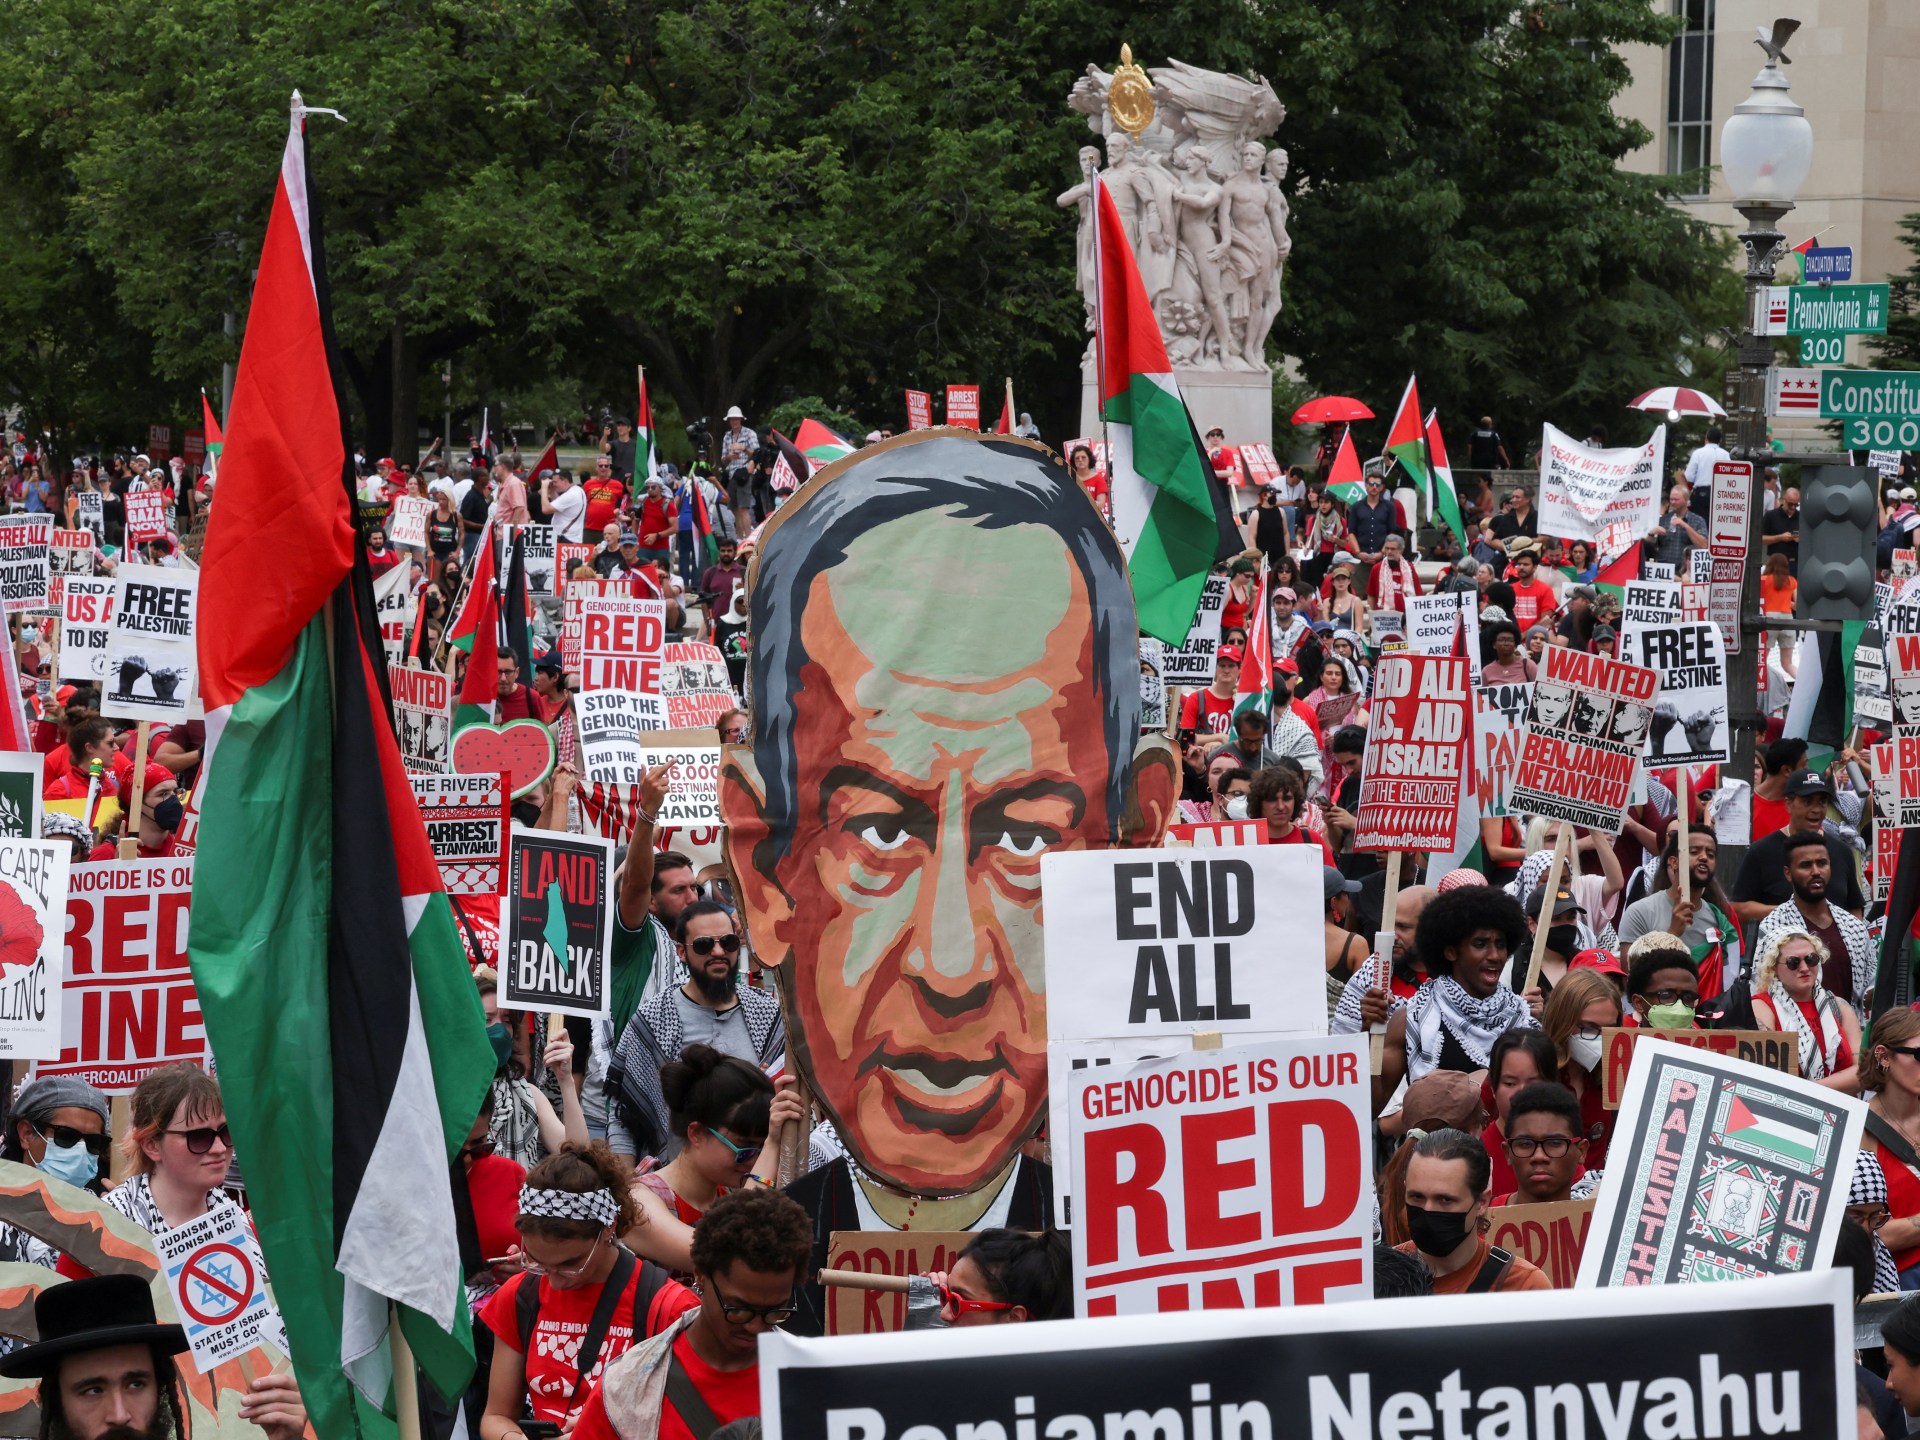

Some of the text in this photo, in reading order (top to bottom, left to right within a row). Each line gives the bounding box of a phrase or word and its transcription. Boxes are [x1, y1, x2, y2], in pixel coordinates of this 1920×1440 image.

[1805, 255, 1850, 274] EVACUATION ROUTE
[1792, 290, 1879, 331] Pennsylvania Ave
[1867, 309, 1879, 327] NW
[1802, 338, 1842, 361] 300
[908, 393, 926, 408] STOP
[948, 391, 977, 403] ARREST
[1828, 377, 1920, 416] Constitu
[1852, 421, 1919, 447] 300
[1726, 479, 1737, 488] NO
[81, 494, 100, 506] FREE
[127, 498, 162, 509] SIEGE ON
[1717, 490, 1746, 500] STANDING
[127, 507, 164, 522] GAZA
[1722, 503, 1746, 512] PARKING
[129, 521, 164, 532] NOW
[409, 516, 423, 528] TO
[1717, 515, 1743, 525] ANYTIME
[27, 525, 48, 545] ALL
[561, 546, 590, 561] STOP
[1654, 567, 1673, 580] ALL
[1713, 562, 1741, 580] RESERVED
[68, 582, 105, 595] END
[567, 580, 600, 600] END
[1627, 587, 1667, 608] FREE
[1725, 588, 1737, 598] STATES
[66, 594, 97, 623] US
[124, 583, 192, 620] FREE
[586, 601, 663, 614] GENOCIDE IS OUR
[1413, 600, 1433, 610] THE
[117, 612, 193, 637] PALESTINE
[564, 621, 581, 638] TO
[584, 613, 662, 653] RED
[67, 629, 85, 648] TO
[1192, 639, 1216, 655] ARE
[1641, 625, 1717, 669] FREE
[583, 658, 661, 695] LINE
[1375, 658, 1413, 698] END
[1418, 659, 1467, 701] ALL
[1546, 647, 1657, 700] WANTED
[1660, 664, 1723, 691] LESTINE
[1855, 670, 1880, 681] THE
[388, 664, 447, 710] WANTED
[584, 694, 661, 715] STOP THE
[666, 694, 736, 713] BENJAMIN
[1477, 684, 1529, 714] FROM
[581, 713, 667, 732] GENOCIDE!
[1370, 699, 1404, 742] U.S.
[1411, 701, 1464, 743] AID
[605, 730, 631, 738] ANSWER
[1529, 723, 1638, 757] WAR CRIMINAL
[403, 757, 445, 775] CRIMINAL
[588, 750, 638, 765] END THE
[700, 753, 719, 765] OF
[1366, 743, 1458, 778] TO ISRAEL
[1521, 733, 1636, 785] BENJAMIN
[1667, 754, 1690, 763] Socialism
[1699, 752, 1725, 761] Liberation
[441, 777, 490, 792] RIVER
[591, 766, 618, 783] ON
[1515, 760, 1630, 810] NETANYAHU
[669, 793, 687, 803] ON
[1361, 781, 1456, 805] STOP THE GENOCIDE
[1513, 785, 1623, 815] FOR CRIMES AGAINST HUMANITY
[1508, 795, 1620, 833] ANSWERCOALITION.ORG
[427, 821, 498, 844] ARREST
[147, 866, 167, 889] IS
[521, 848, 597, 907] LAND
[1113, 858, 1255, 941] END
[518, 938, 594, 998] BACK
[1128, 942, 1251, 1024] ALL
[1082, 1052, 1359, 1120] GENOCIDE IS OUR
[1083, 1097, 1363, 1267] RED
[159, 1207, 236, 1250] JUDAISM YES!
[166, 1219, 236, 1260] ZIONISM NO!
[194, 1307, 270, 1351] STATE OF ISRAEL
[538, 1320, 634, 1338] ARMS NOW
[210, 1334, 239, 1355] MUST
[217, 1336, 260, 1360] www.nkusa.org
[1308, 1353, 1800, 1440] Netanyahu
